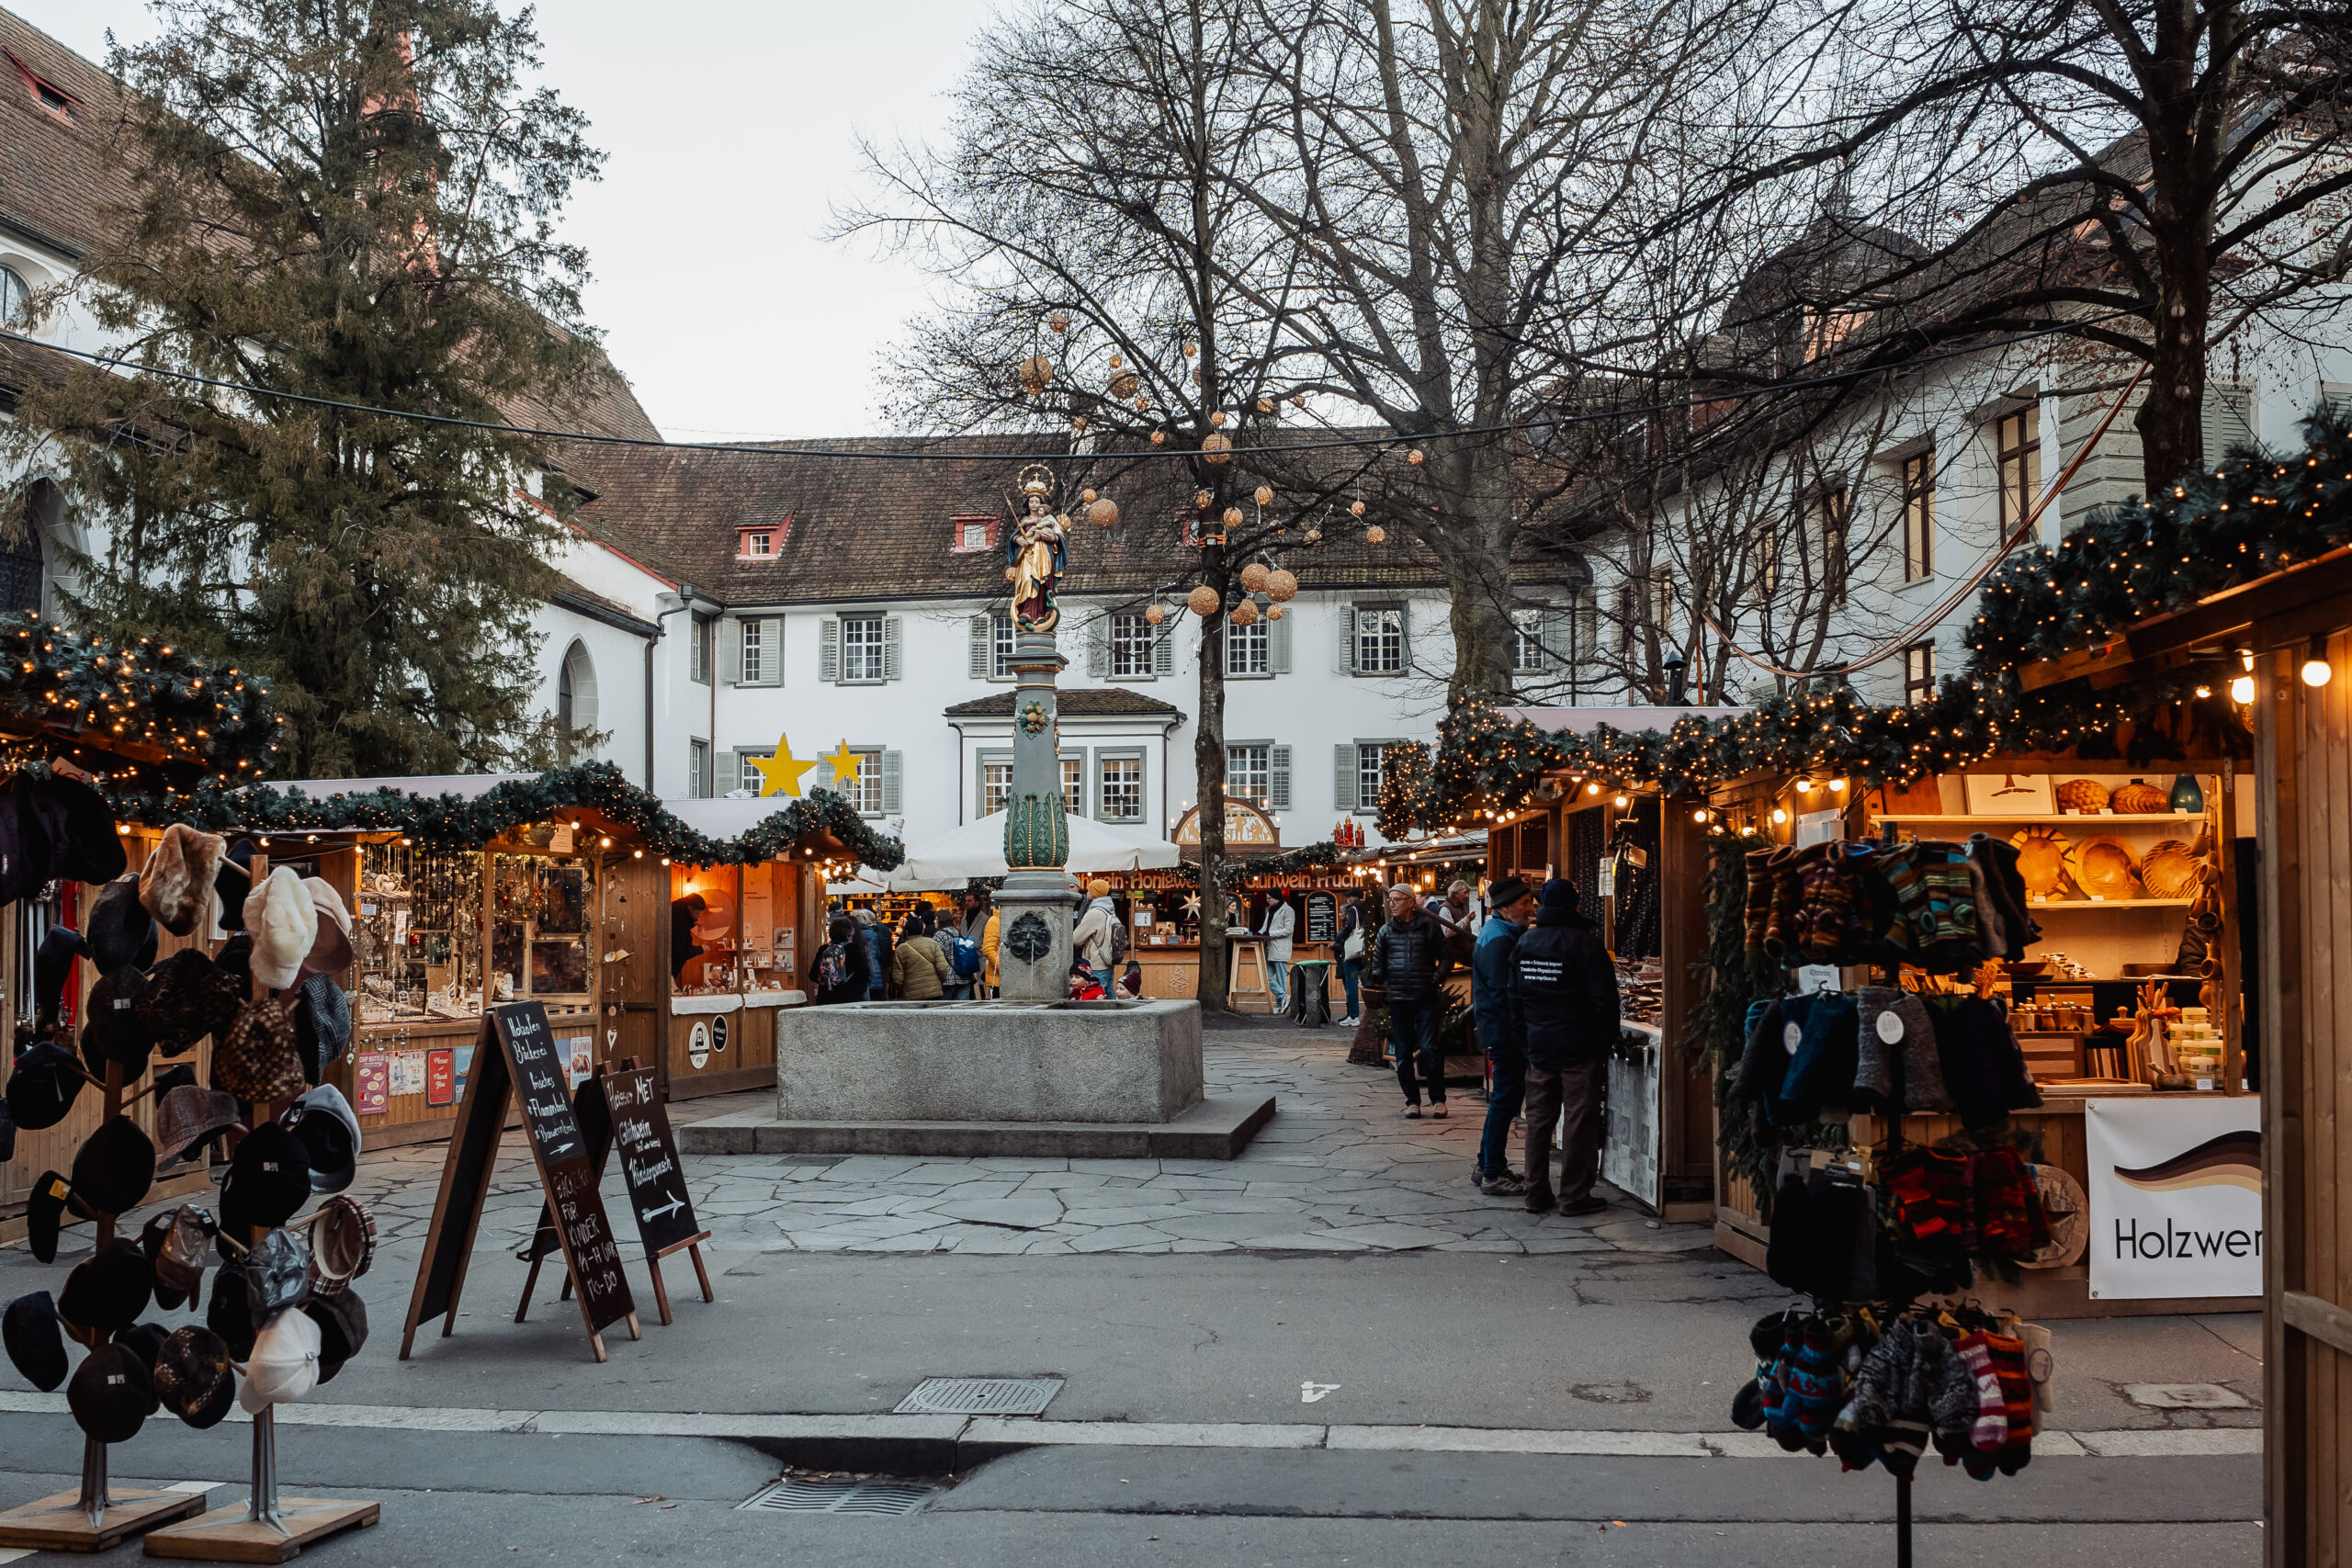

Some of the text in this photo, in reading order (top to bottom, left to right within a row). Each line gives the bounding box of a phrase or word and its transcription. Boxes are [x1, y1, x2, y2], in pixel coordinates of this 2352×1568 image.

[1130, 872, 1200, 889] Honigwe
[571, 1041, 592, 1054] SEAFOOD
[435, 1080, 447, 1090] You
[635, 1075, 654, 1105] MET
[618, 1117, 652, 1146] Glühwein
[628, 1151, 673, 1189] Kinderpunsch
[560, 1201, 579, 1221] FÜR
[568, 1213, 601, 1247] KINDER
